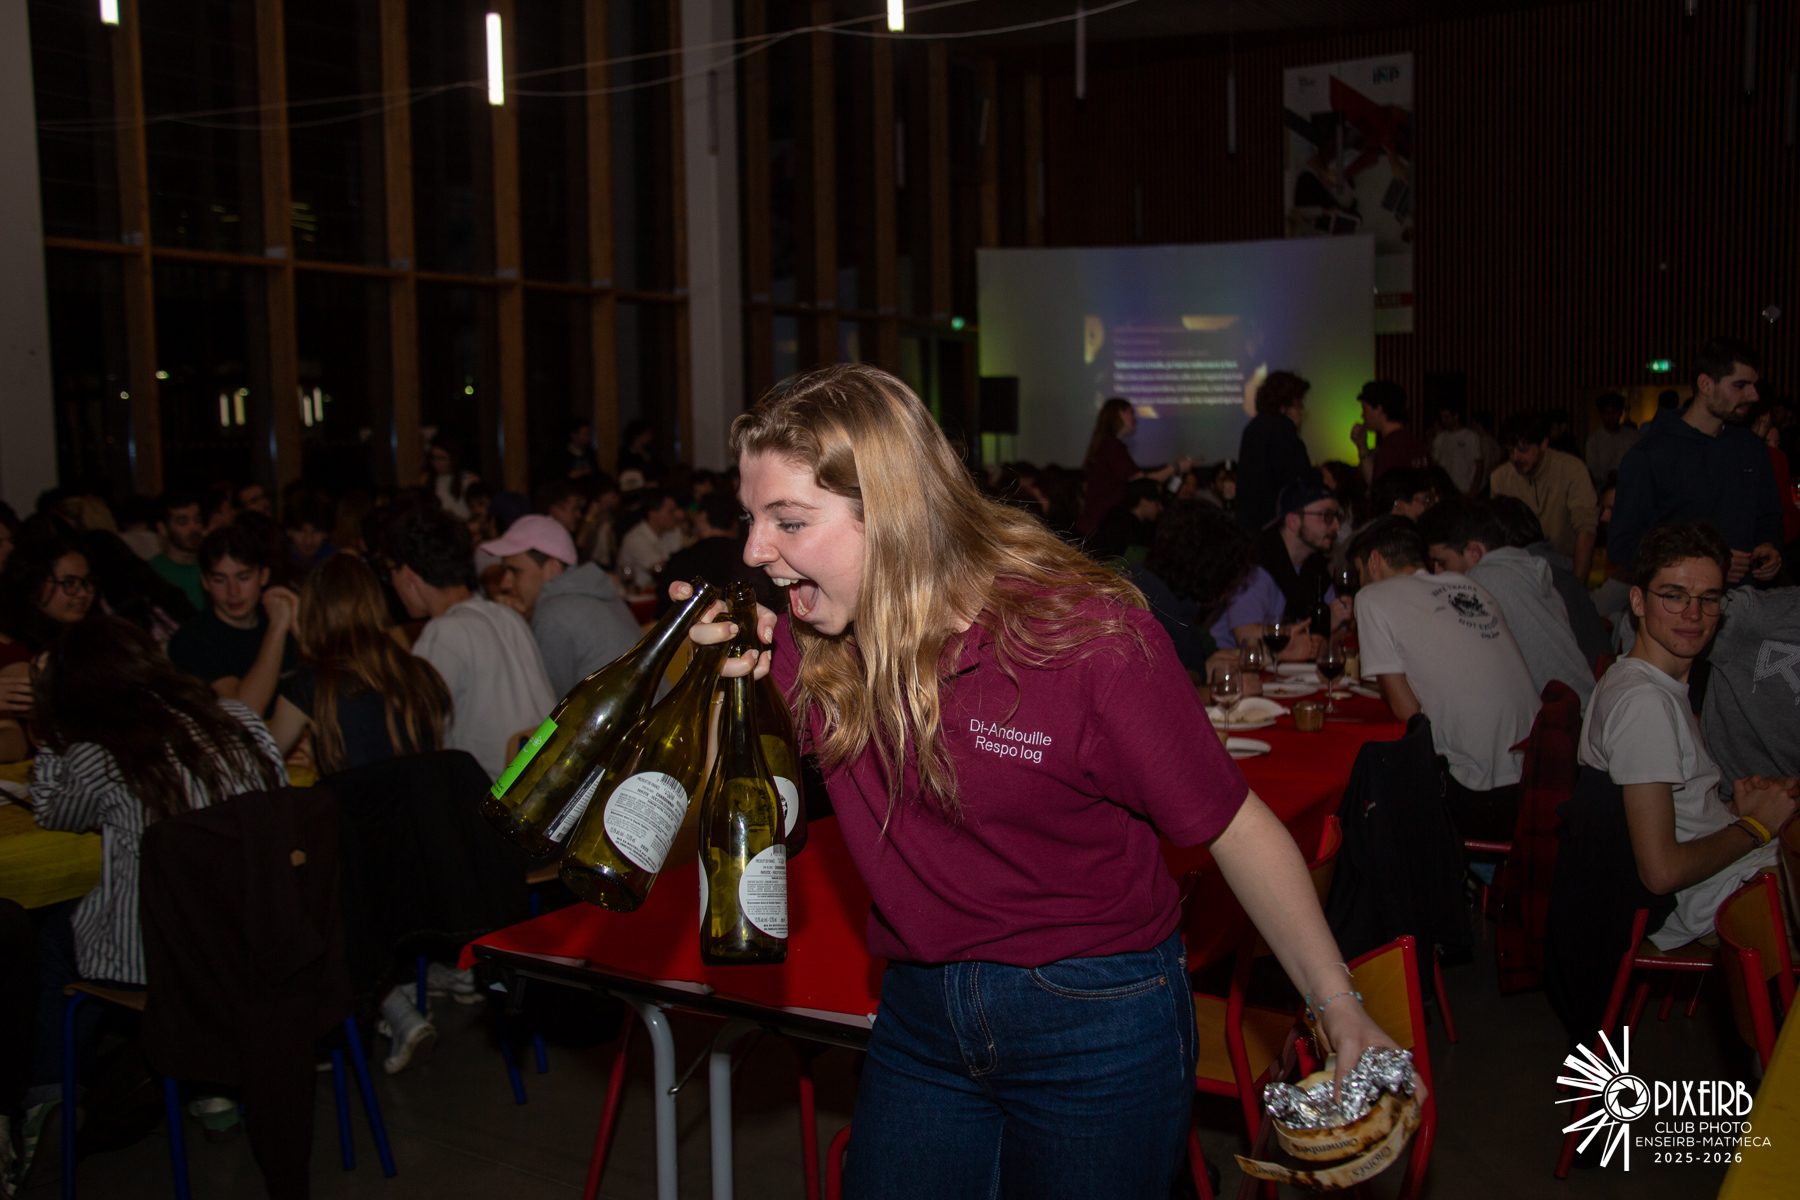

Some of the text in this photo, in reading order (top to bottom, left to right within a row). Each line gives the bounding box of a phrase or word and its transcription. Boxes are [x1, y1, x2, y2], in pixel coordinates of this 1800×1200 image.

[970, 718, 1052, 746] Di-Andouille
[975, 735, 1043, 764] Respo log
